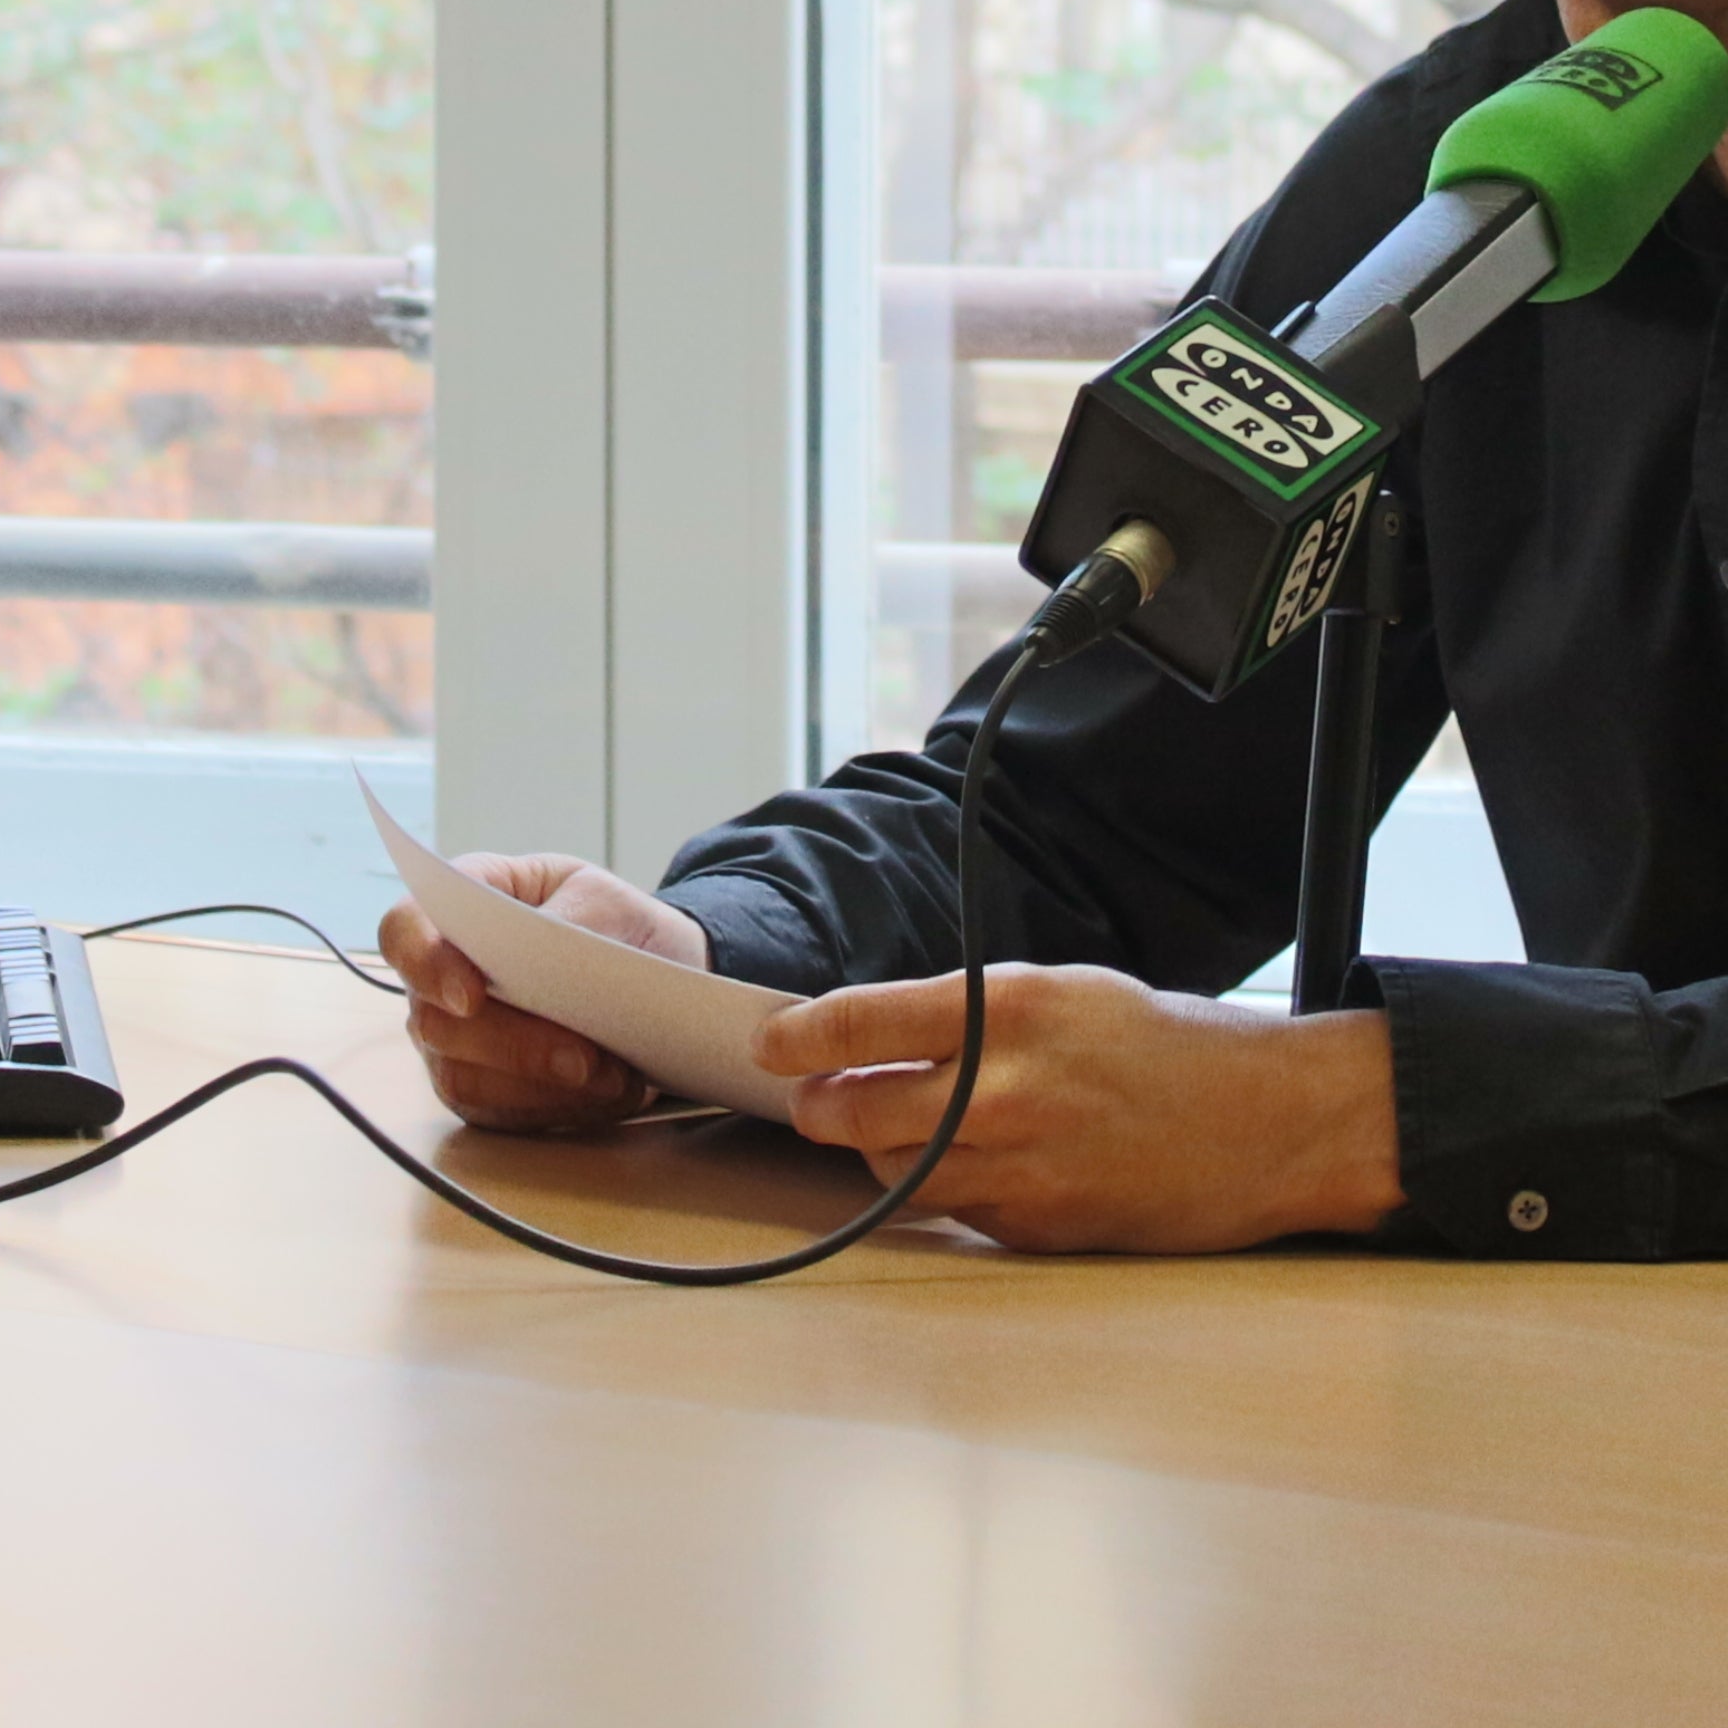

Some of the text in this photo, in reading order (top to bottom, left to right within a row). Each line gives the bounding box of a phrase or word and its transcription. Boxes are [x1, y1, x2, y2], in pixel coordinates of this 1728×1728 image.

[1176, 379, 1290, 454] CERO
[1200, 348, 1319, 434] ONDA
[1273, 534, 1319, 631] CERO
[1303, 500, 1354, 608] ONDA
